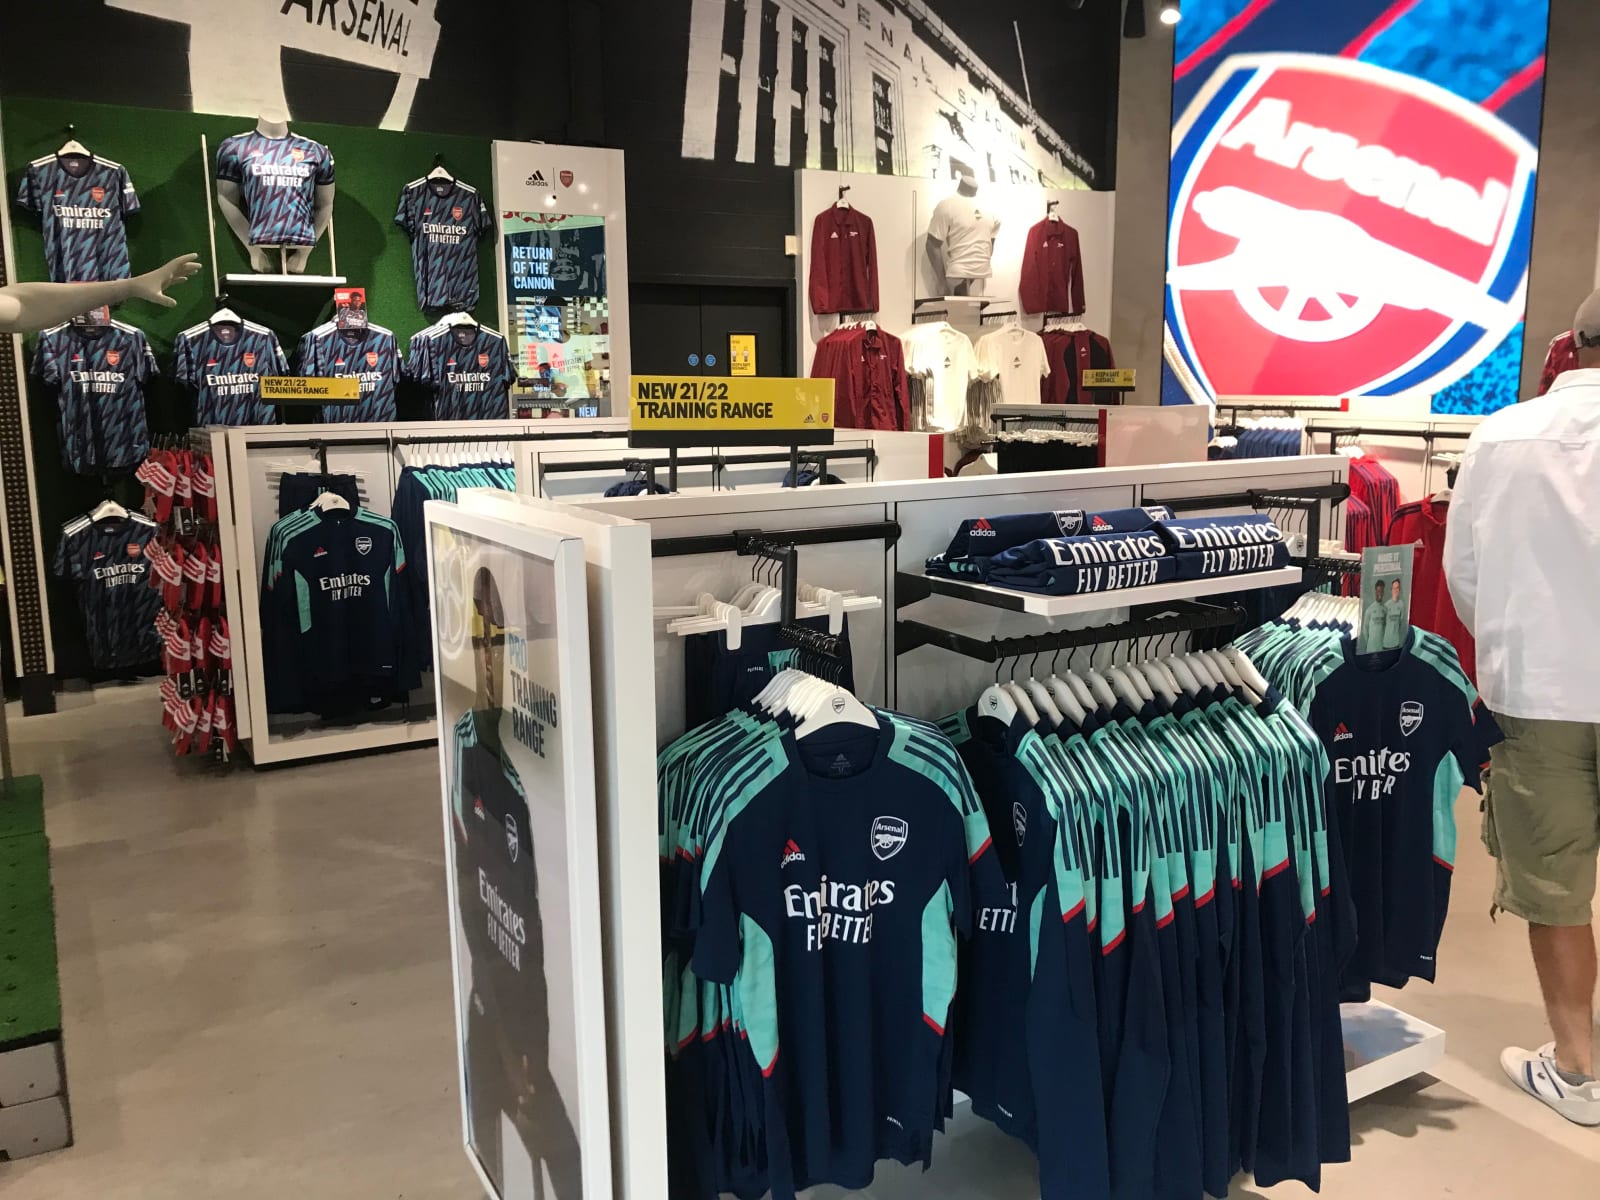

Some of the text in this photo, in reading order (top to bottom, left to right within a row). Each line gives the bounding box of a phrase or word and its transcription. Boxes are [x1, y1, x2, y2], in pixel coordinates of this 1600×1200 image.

[251, 163, 310, 177] Emirates
[1219, 97, 1509, 247] Arsenal
[263, 176, 302, 187] FLY BETTER
[53, 204, 111, 217] Emirates
[63, 217, 104, 229] FLY BETTER
[422, 222, 467, 235] Emirates
[512, 246, 553, 260] RETURN
[513, 261, 549, 275] OF THE
[514, 276, 555, 290] CANNON
[70, 369, 125, 382] Emirates
[206, 372, 259, 386] Emirates
[446, 371, 491, 383] Emirates
[264, 386, 302, 394] TRAINING
[284, 379, 307, 387] 21/22
[217, 386, 228, 396] FLY
[638, 381, 728, 401] NEW 21/22
[579, 406, 598, 417] NEW
[637, 401, 773, 418] TRAINING RANGE
[970, 523, 1113, 537] adidas adidas
[1167, 521, 1284, 549] Emirates
[1048, 532, 1166, 566] Emirates
[1202, 542, 1275, 574] FLY BETTER
[94, 562, 145, 580] Emirates
[1076, 560, 1159, 594] FLY BETTER
[508, 632, 528, 673] PRO
[510, 670, 558, 729] TRAINING
[512, 706, 545, 759] RANGE
[877, 823, 903, 834] Arsenal
[781, 851, 806, 869] adidas
[783, 874, 895, 919] Emirates
[478, 866, 526, 945] Emirates
[807, 912, 873, 952] FL BETTE
[487, 912, 520, 972] FLY BETTER
